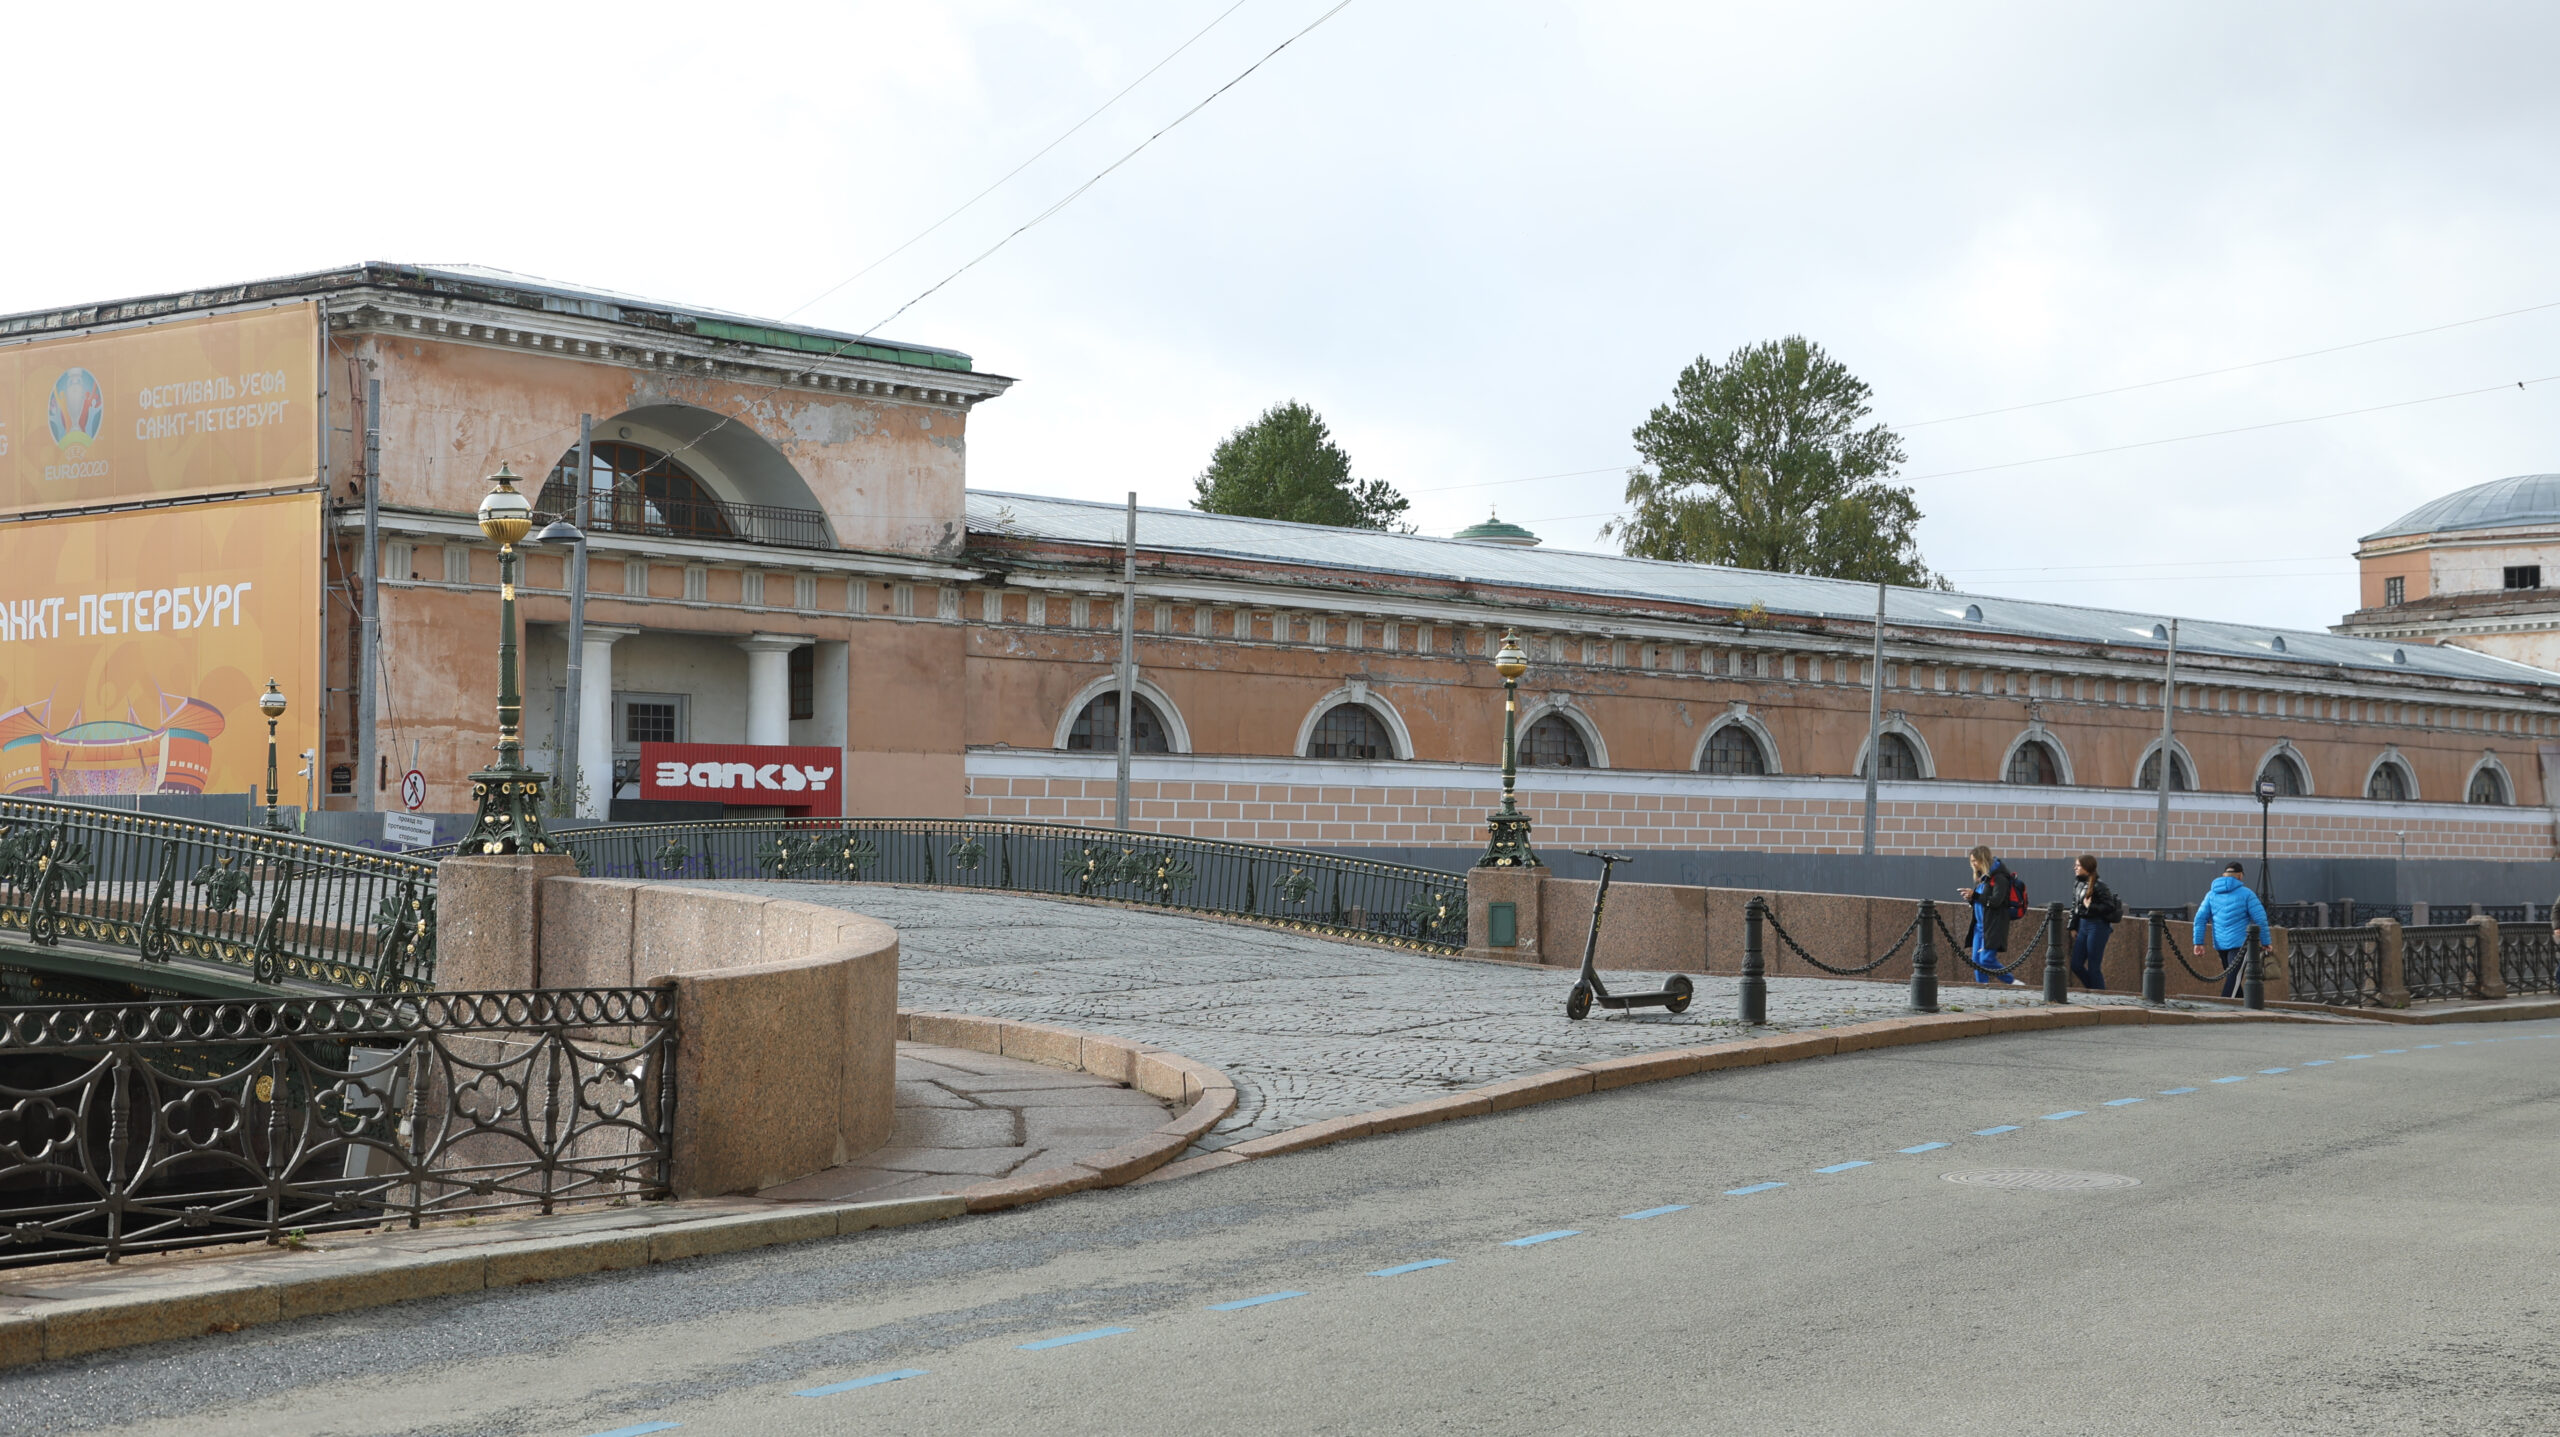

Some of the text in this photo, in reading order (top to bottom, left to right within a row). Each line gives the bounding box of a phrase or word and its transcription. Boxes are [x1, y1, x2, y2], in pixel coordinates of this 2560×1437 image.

[139, 369, 286, 410] ФЕСТИВАЛЬ УЕФА
[136, 399, 290, 441] САНКТ-ПЕТЕРБУРГ
[44, 460, 109, 481] EURO2020
